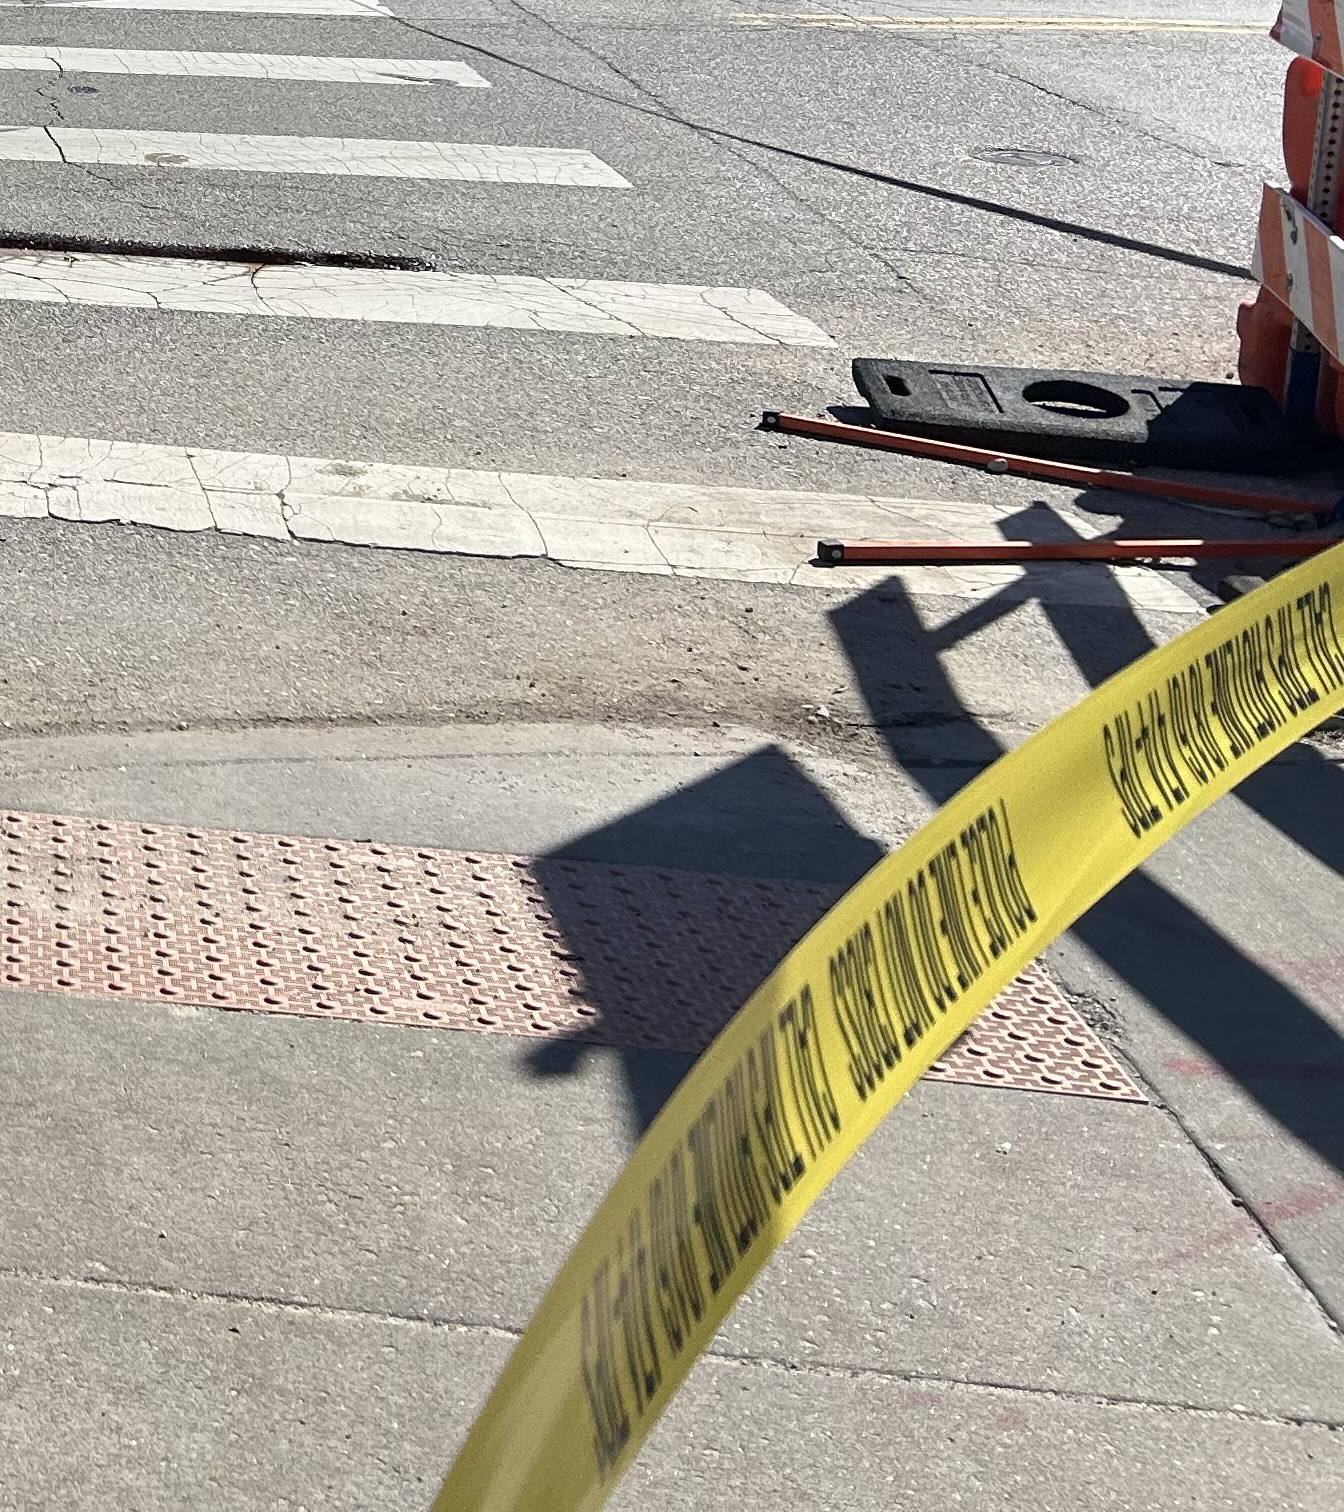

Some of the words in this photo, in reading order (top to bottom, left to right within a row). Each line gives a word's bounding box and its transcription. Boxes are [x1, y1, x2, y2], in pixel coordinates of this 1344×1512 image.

[928, 838, 991, 993] LINE
[961, 797, 1038, 960] POLICE
[828, 919, 902, 1102] CROSS
[876, 888, 935, 1049] NOT
